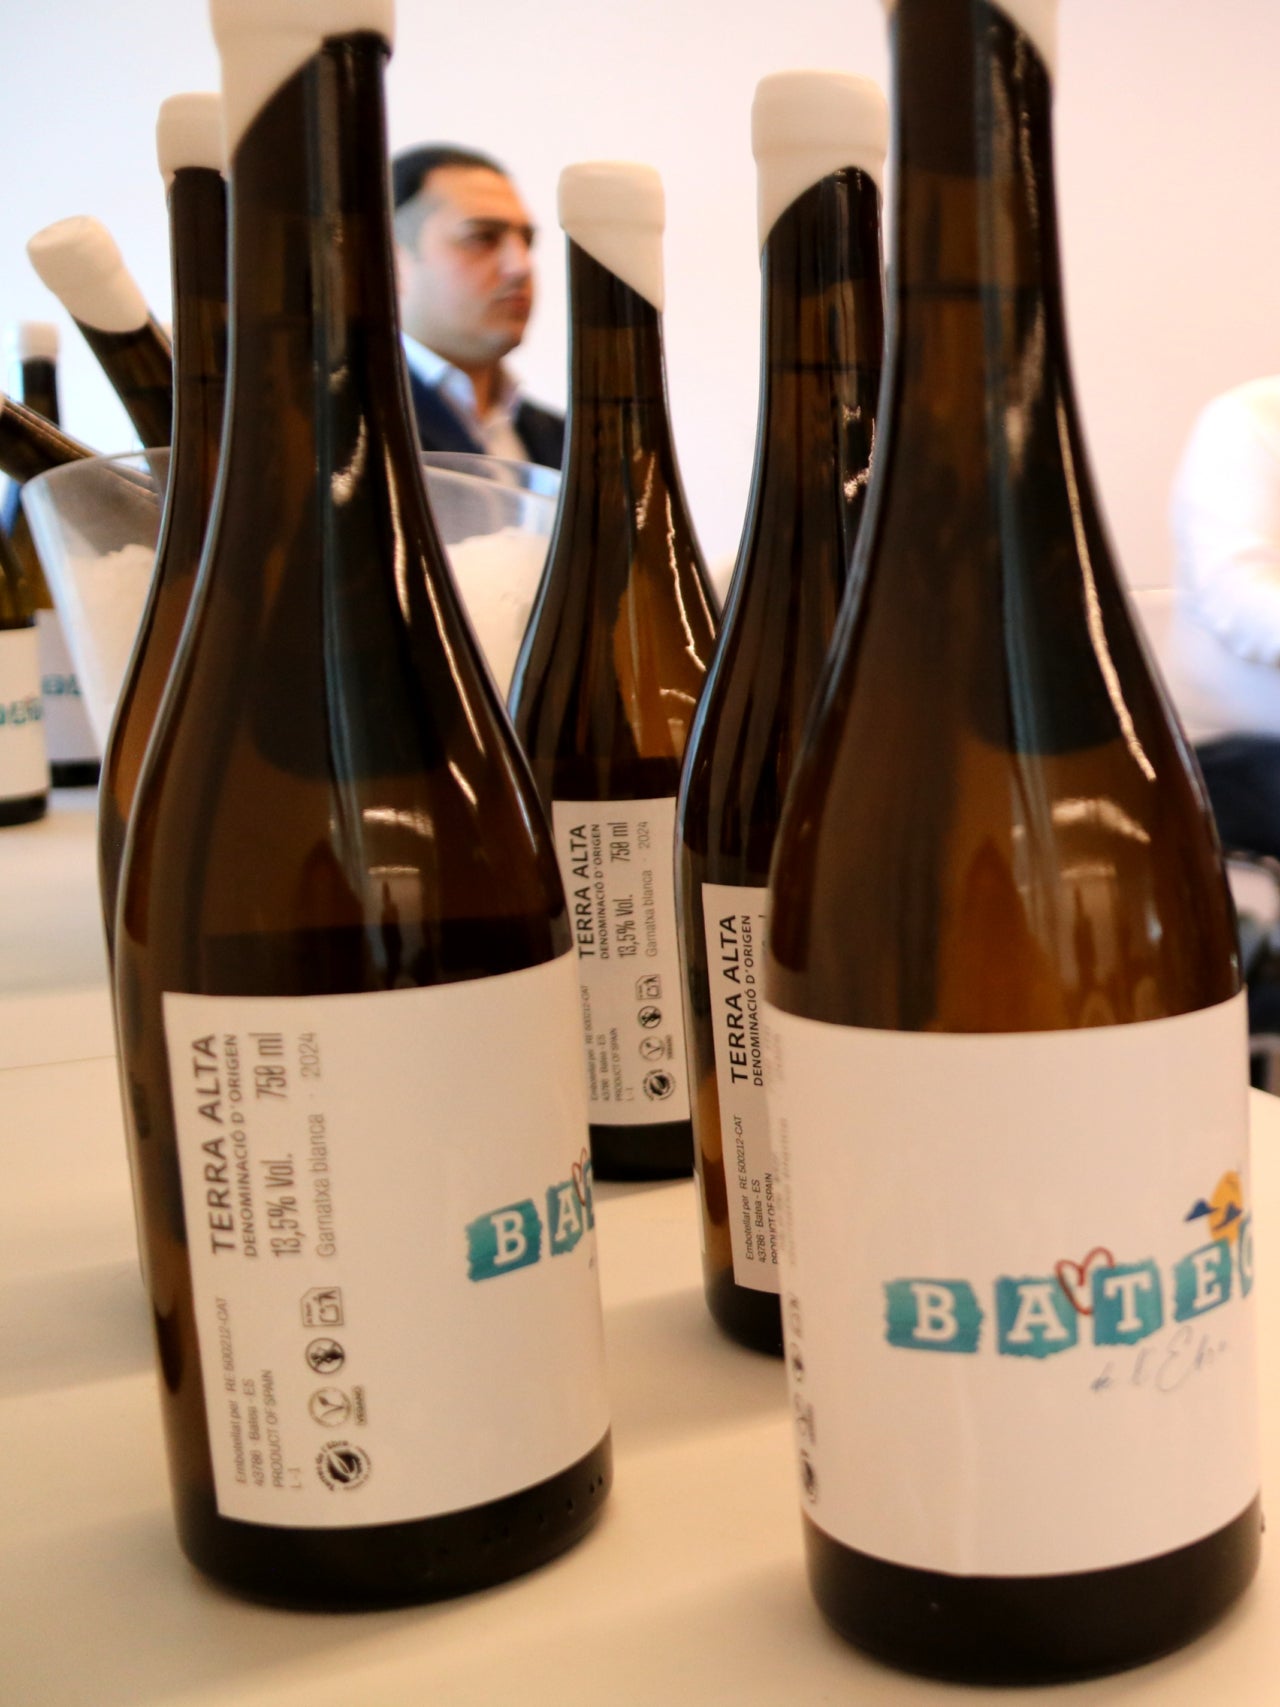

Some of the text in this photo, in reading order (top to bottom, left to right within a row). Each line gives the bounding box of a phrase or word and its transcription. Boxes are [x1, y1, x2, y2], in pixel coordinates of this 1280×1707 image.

[569, 825, 595, 959] TERRA ALTA
[596, 882, 609, 959] DENOMINACIÓ
[608, 822, 640, 957] 13,5% Vol. 750 ml
[637, 821, 658, 957] Garnatxa blanca 2024
[719, 914, 748, 1084] TERRA ALTA
[745, 989, 763, 1087] DENOMINACIÓ
[191, 1033, 236, 1254] TERRA ALTA
[231, 1130, 258, 1258] DENOMINACIÓ
[248, 1032, 306, 1258] 13,5% Vol. 750 ml
[298, 1032, 336, 1258] Garnatxa blanca 2024
[733, 1115, 754, 1261] Embotellat per RE 500212-CAT
[764, 1173, 774, 1201] SPAIN
[751, 1179, 767, 1263] 43786 Batea ES
[226, 1375, 235, 1392] RE
[230, 1401, 240, 1418] per
[244, 1379, 254, 1396] ES
[248, 1407, 260, 1440] Batea
[263, 1370, 283, 1488] PRODUCT OF SPAIN
[232, 1421, 246, 1483] Embotellat
